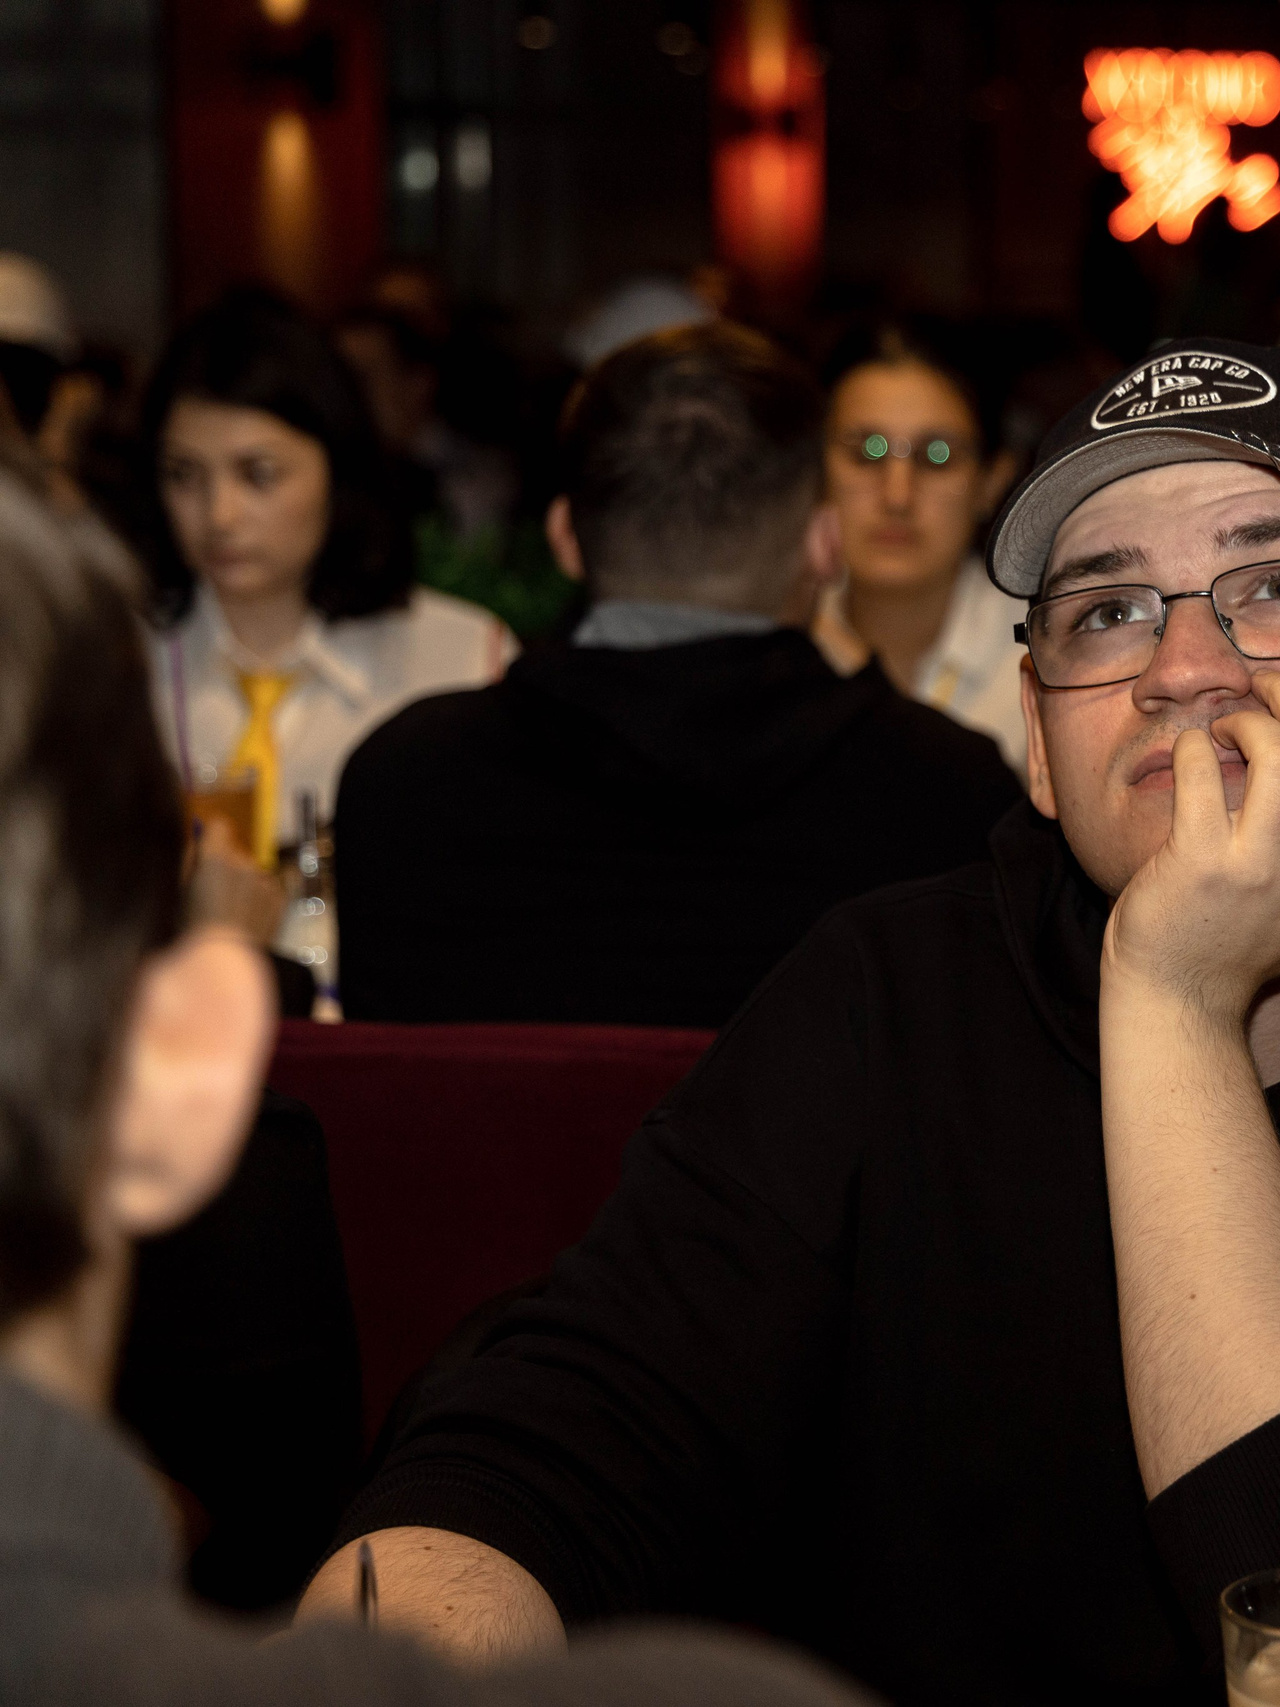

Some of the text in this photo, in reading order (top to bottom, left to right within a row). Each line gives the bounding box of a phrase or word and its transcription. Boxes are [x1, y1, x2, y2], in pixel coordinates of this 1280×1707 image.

[1114, 370, 1146, 398] NEW
[1151, 357, 1182, 376] ERA
[1188, 356, 1223, 372] CAP
[1179, 391, 1223, 408] 1920
